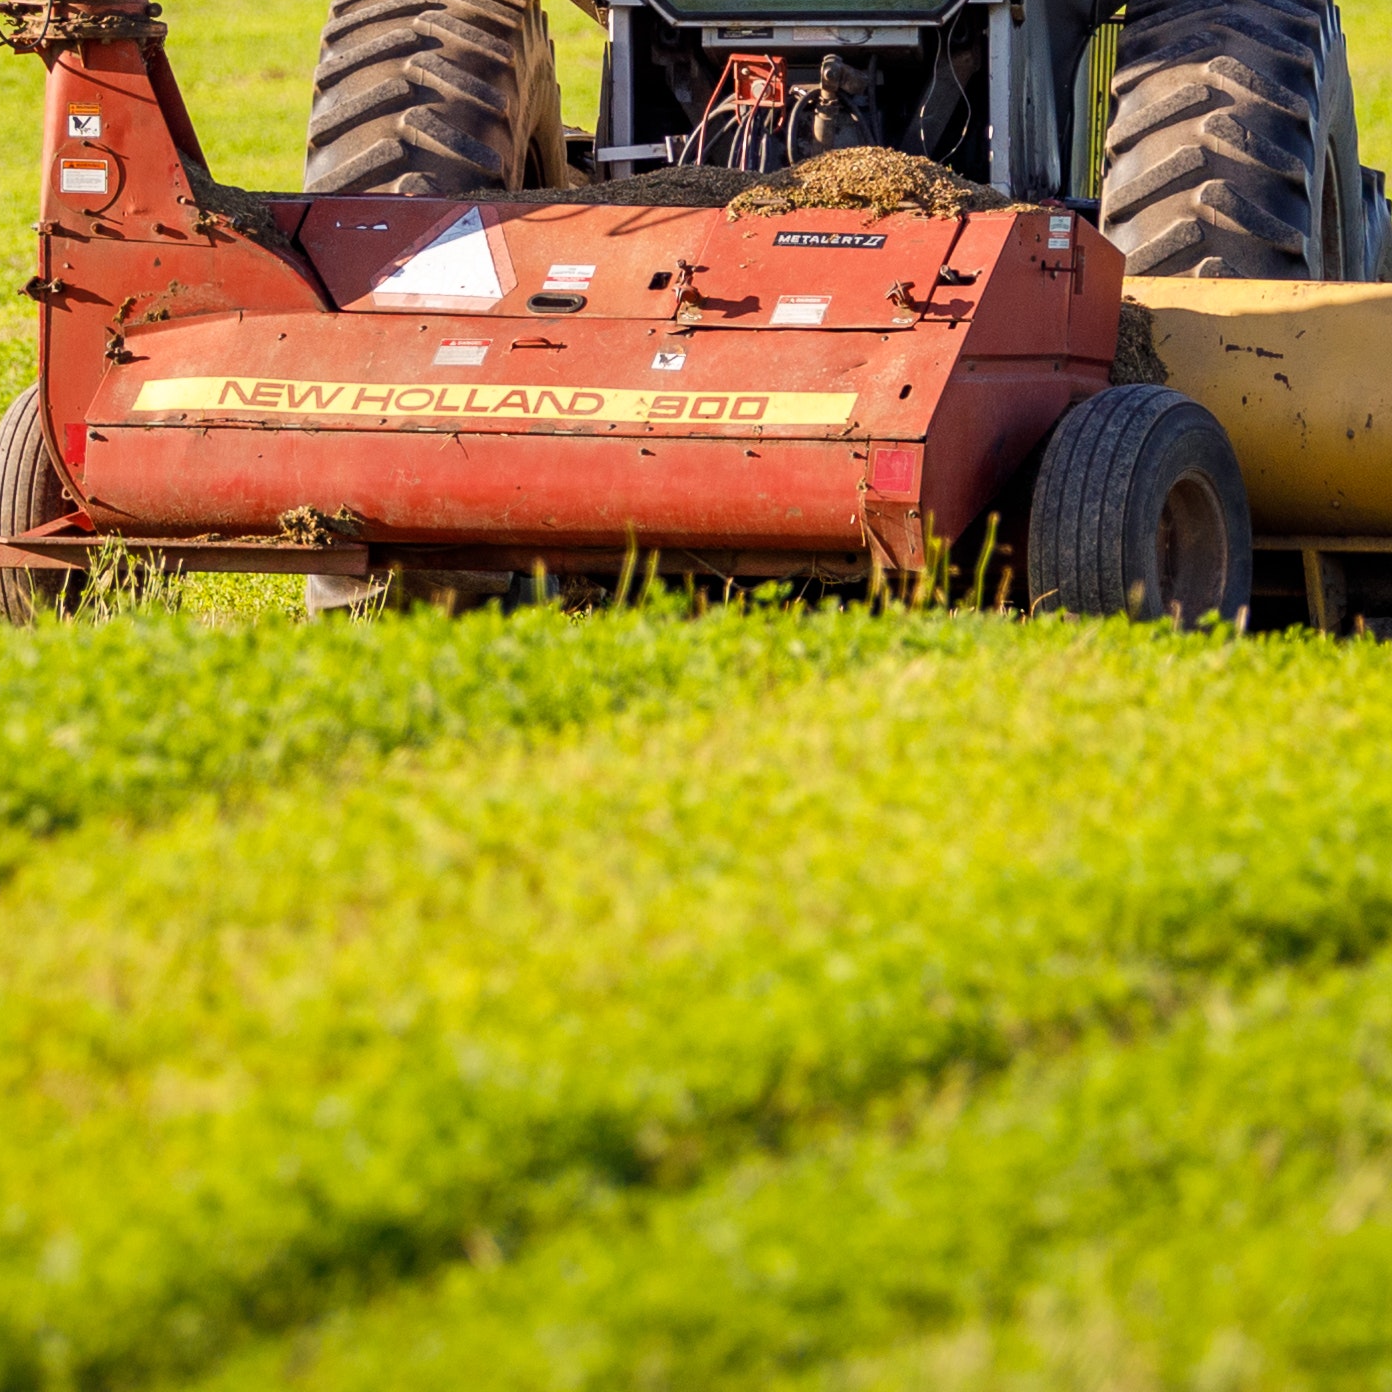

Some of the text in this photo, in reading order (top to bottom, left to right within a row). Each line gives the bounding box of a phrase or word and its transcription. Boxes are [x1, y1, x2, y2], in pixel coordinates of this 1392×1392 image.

[777, 233, 864, 246] METALERT
[219, 380, 770, 420] NEW HOLLAND 900
